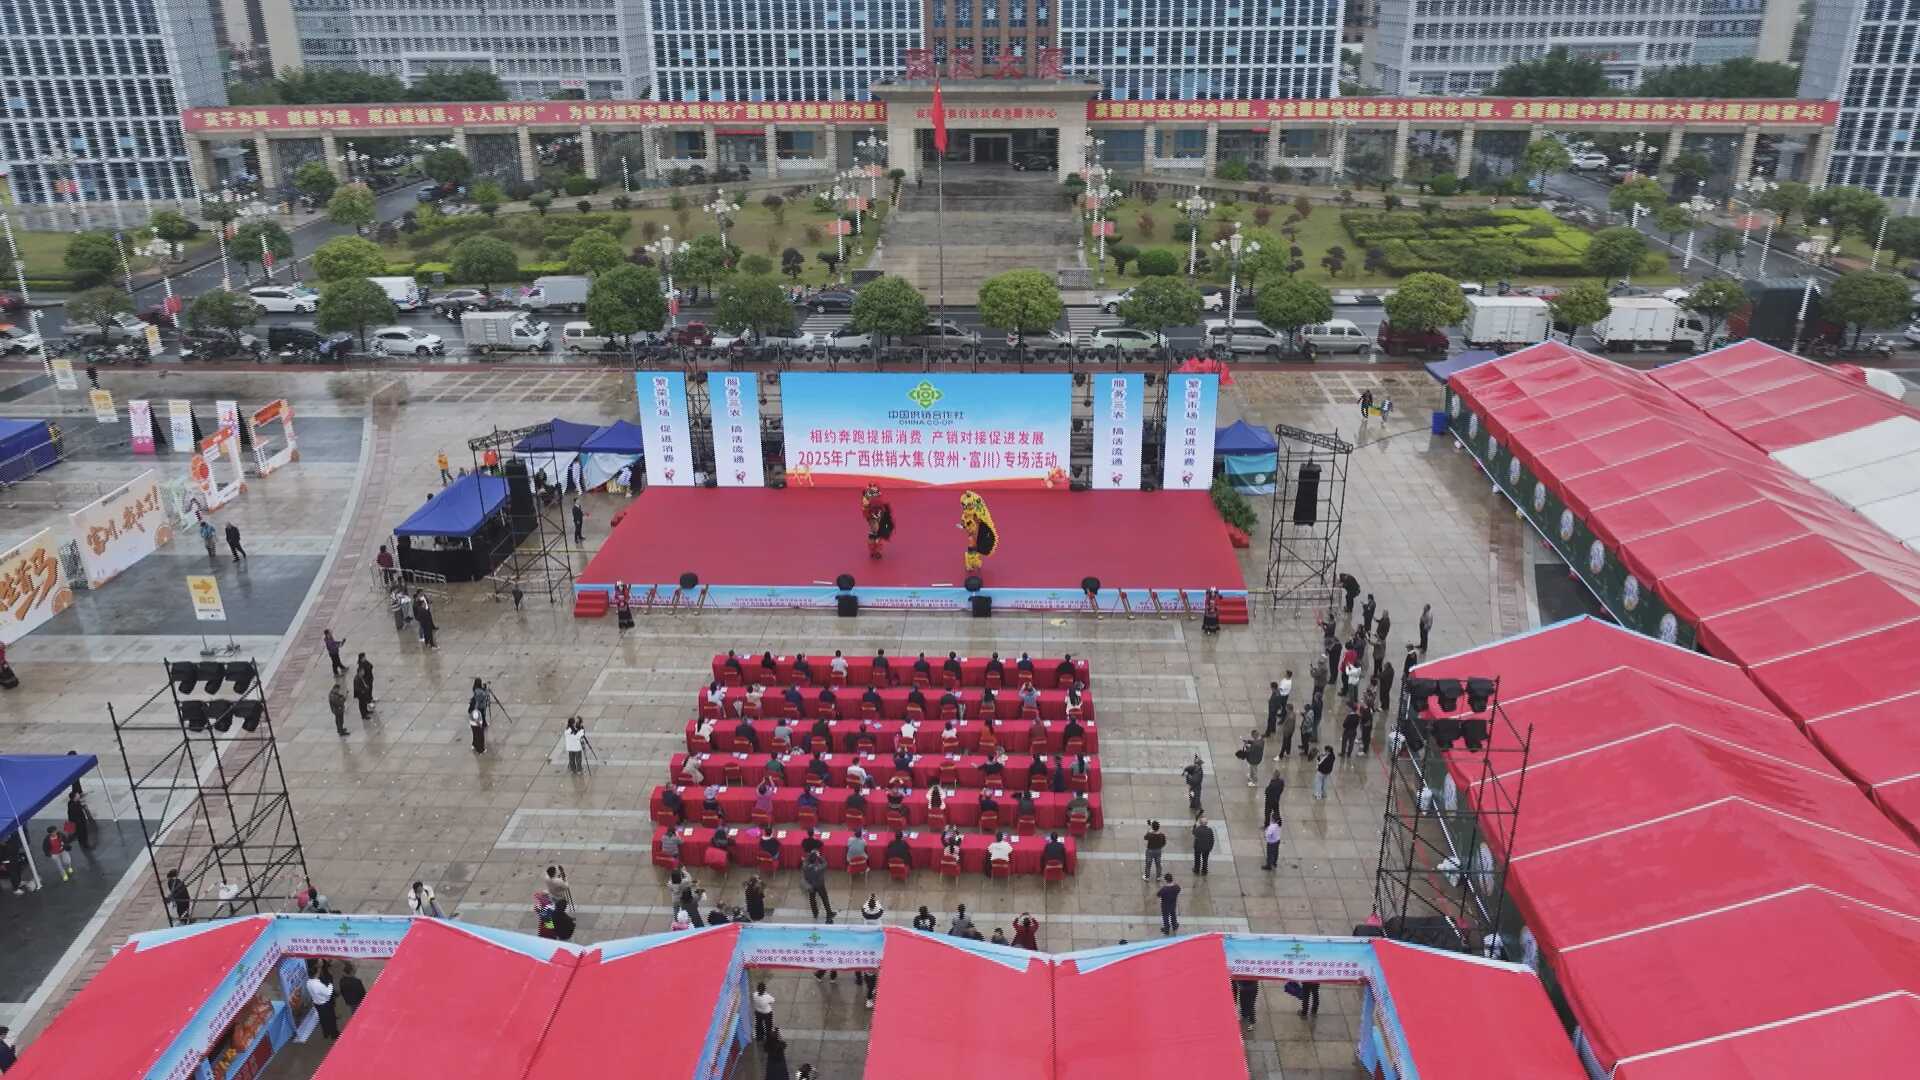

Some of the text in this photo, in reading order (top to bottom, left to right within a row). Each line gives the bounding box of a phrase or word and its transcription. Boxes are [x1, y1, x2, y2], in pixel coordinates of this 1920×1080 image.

[654, 377, 675, 463] 繁荣市场 促进消费
[726, 377, 744, 464] 服务三农 搞活流通
[810, 429, 1045, 445] 相约奔跑提振消费 产销对接促进发展
[888, 410, 965, 419] 中国供销合作社
[1111, 379, 1126, 465] 服务三农 搞活流通
[1184, 379, 1201, 465] 繁荣市场 促进消费
